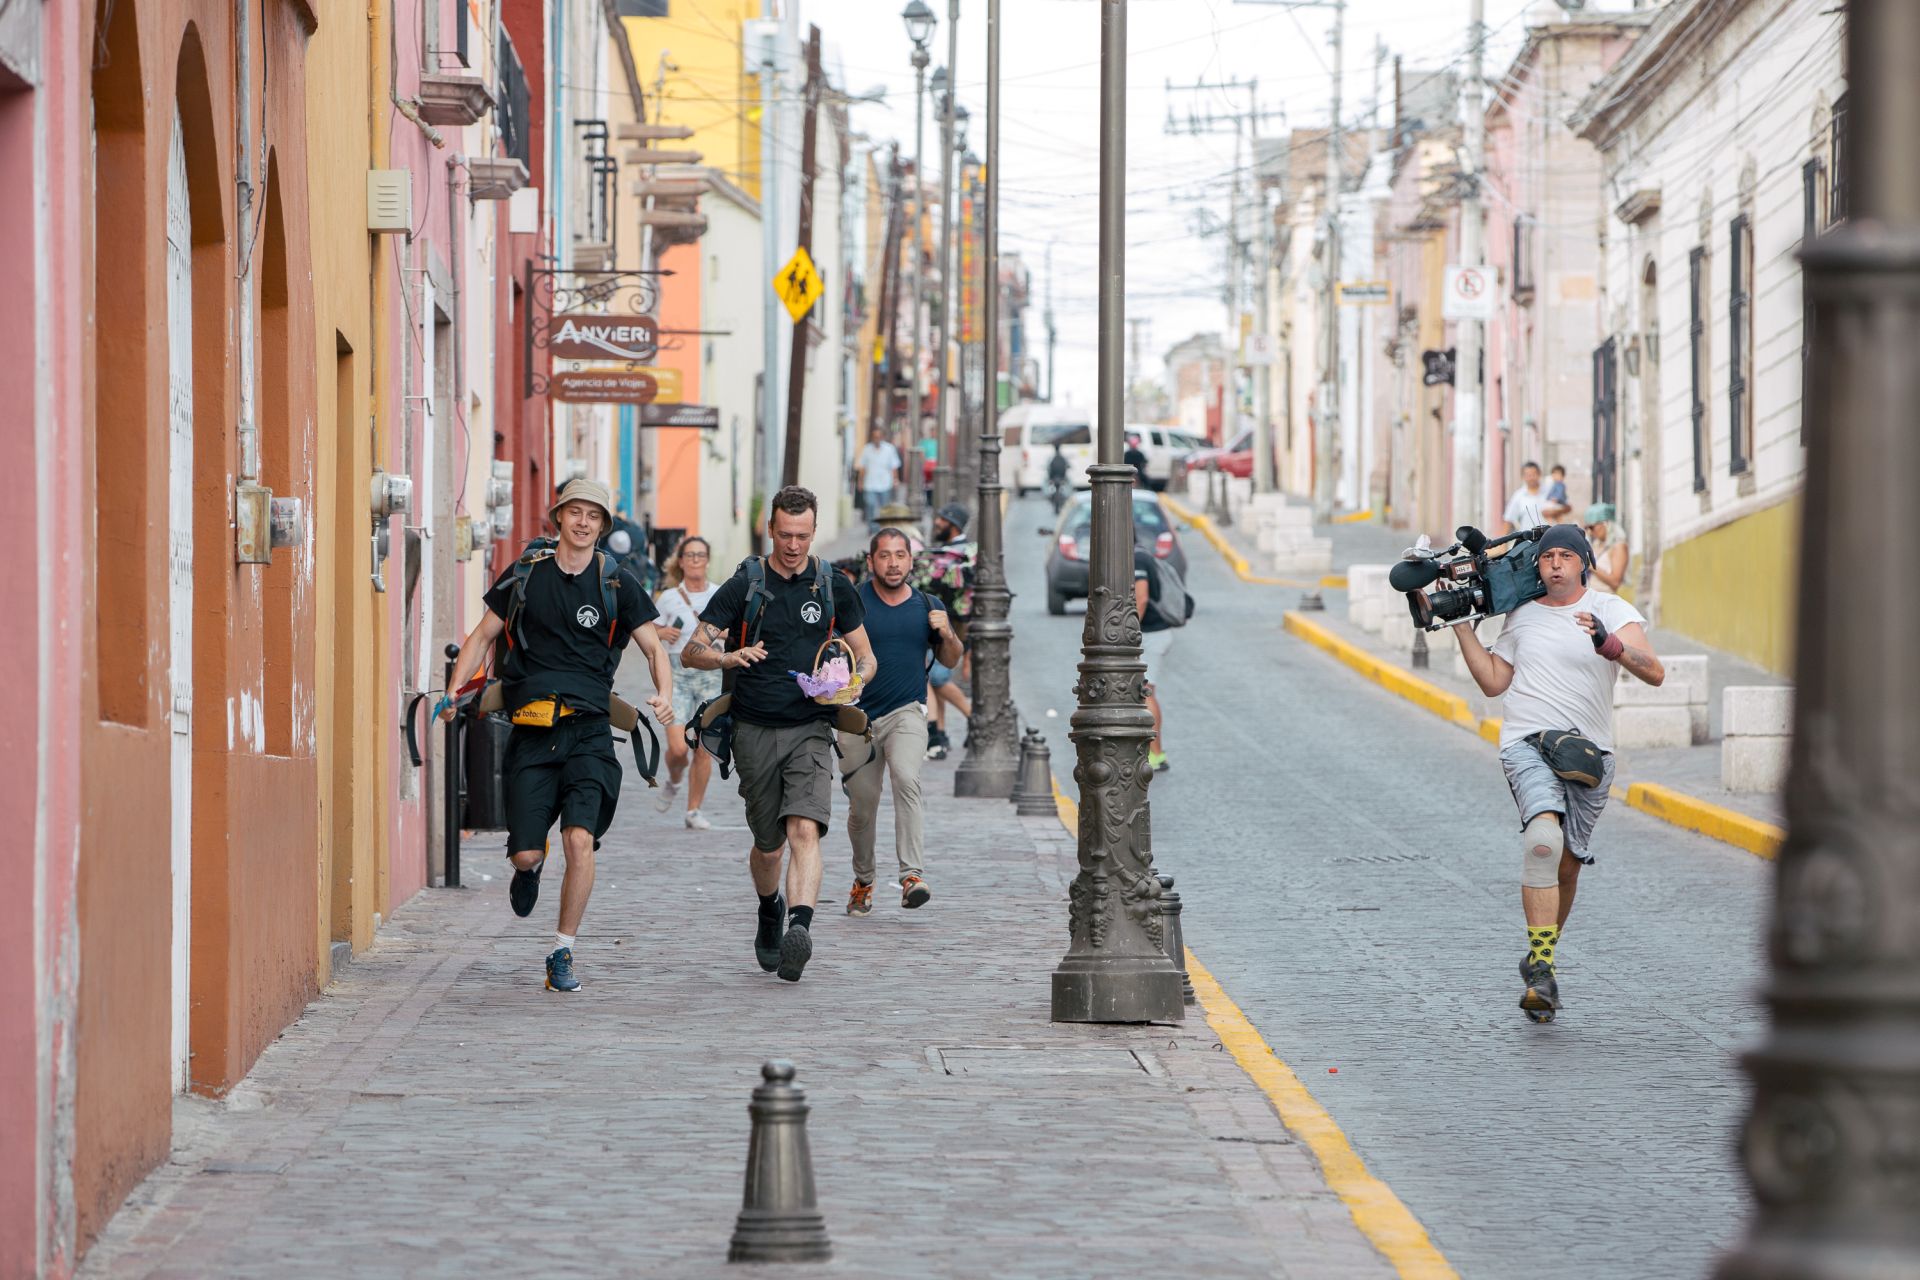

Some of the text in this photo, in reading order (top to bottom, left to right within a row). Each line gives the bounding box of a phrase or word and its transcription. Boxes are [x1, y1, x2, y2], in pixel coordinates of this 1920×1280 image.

[562, 377, 647, 390] Agencia de Viajes
